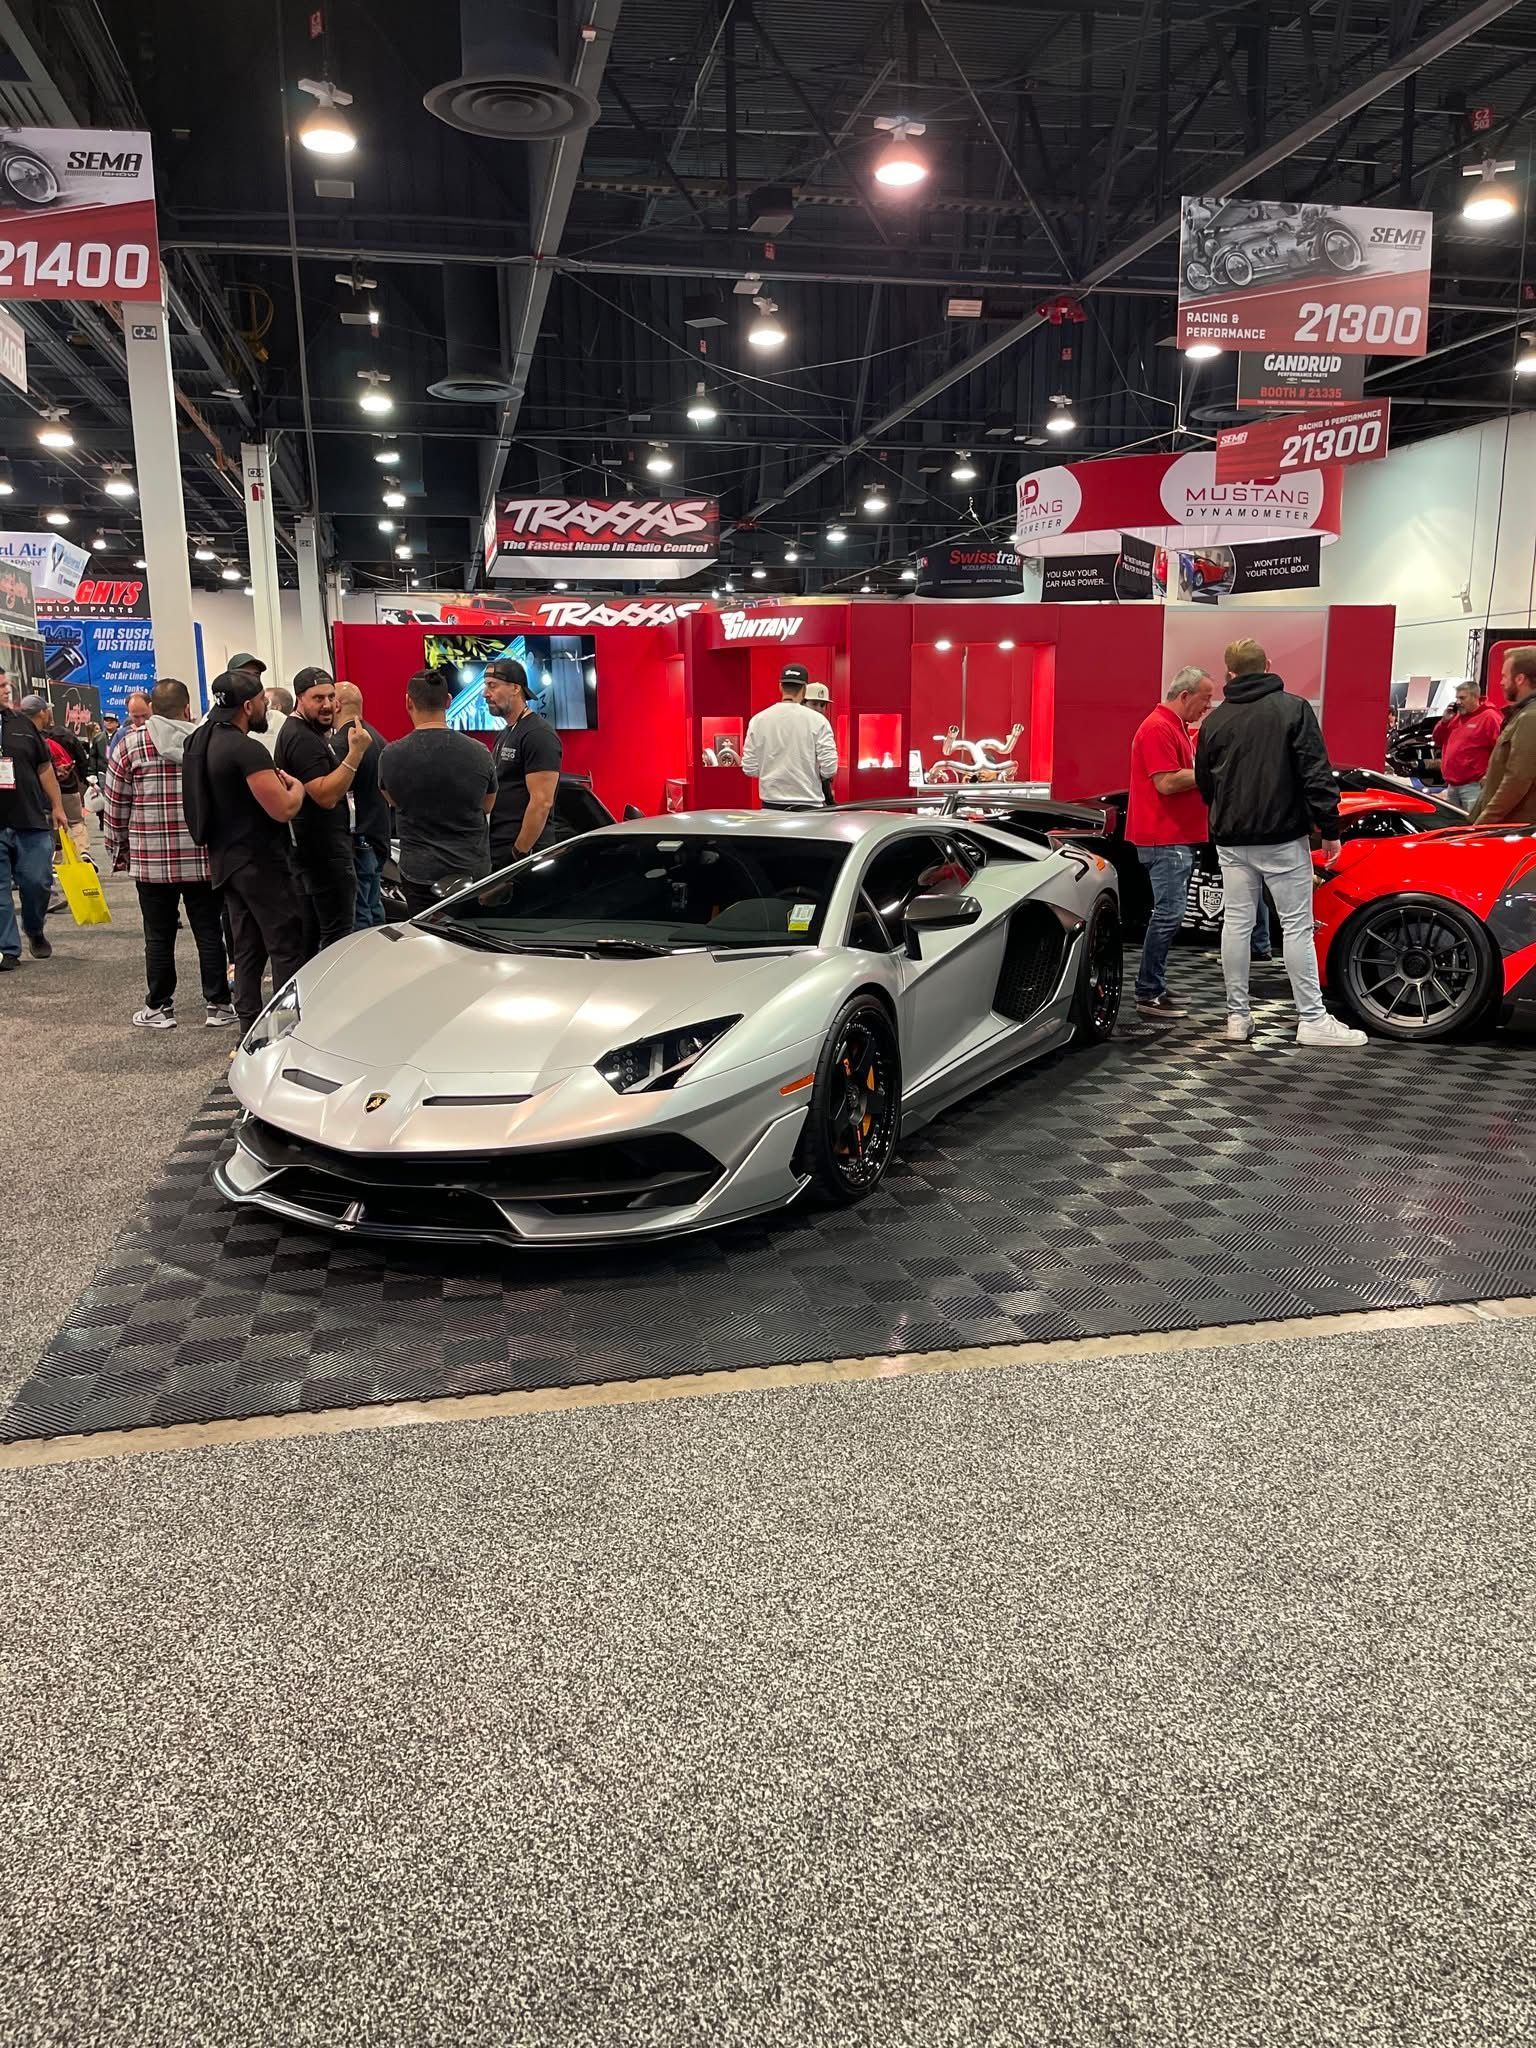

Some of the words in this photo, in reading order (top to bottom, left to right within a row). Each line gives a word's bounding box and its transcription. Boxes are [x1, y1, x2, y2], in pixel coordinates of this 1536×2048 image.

[67, 151, 143, 171] SEMA
[1369, 227, 1426, 245] SEMA
[0, 240, 149, 289] 21400
[1186, 312, 1228, 324] RACING
[1231, 314, 1239, 324] &
[1294, 302, 1422, 345] 21300
[133, 326, 157, 338] C2-4
[1186, 327, 1266, 340] PERFORMANCE
[0, 334, 24, 381] 400
[1263, 353, 1342, 373] GANDRUD
[1260, 386, 1297, 398] BOOTH
[1299, 388, 1306, 397] #
[1308, 388, 1342, 399] 21335
[1298, 420, 1324, 431] RACING
[1330, 409, 1382, 425] PERFORMANCE
[1220, 431, 1248, 445] SEMA
[1279, 420, 1382, 468] 21300
[1186, 487, 1309, 505] MUSTANG
[504, 499, 708, 537] TRAXXAS
[1186, 507, 1308, 520] DYNAMOMETER
[20, 543, 47, 556] Air
[503, 540, 525, 550] The
[528, 541, 573, 551] Fastest
[575, 541, 610, 552] Name
[612, 542, 624, 552] In
[626, 542, 662, 553] Radio
[663, 543, 708, 553] Control
[949, 549, 1019, 566] Swisstrax
[1279, 557, 1292, 565] FIT
[1293, 556, 1301, 564] IN
[1046, 570, 1061, 579] YOU
[1062, 569, 1076, 578] SAY
[1076, 568, 1098, 577] YOUR
[1246, 568, 1268, 577] YOUR
[1269, 567, 1289, 576] TOOL
[1290, 564, 1310, 574] BOX!
[1045, 580, 1060, 588] CAR
[1061, 579, 1076, 587] HAS
[537, 602, 703, 626] TRAXXAS
[720, 611, 803, 641] GINTANI
[93, 628, 116, 639] AIR
[111, 661, 122, 669] Air
[123, 661, 140, 670] Bags
[112, 685, 123, 693] Air
[124, 685, 144, 693] Tanks
